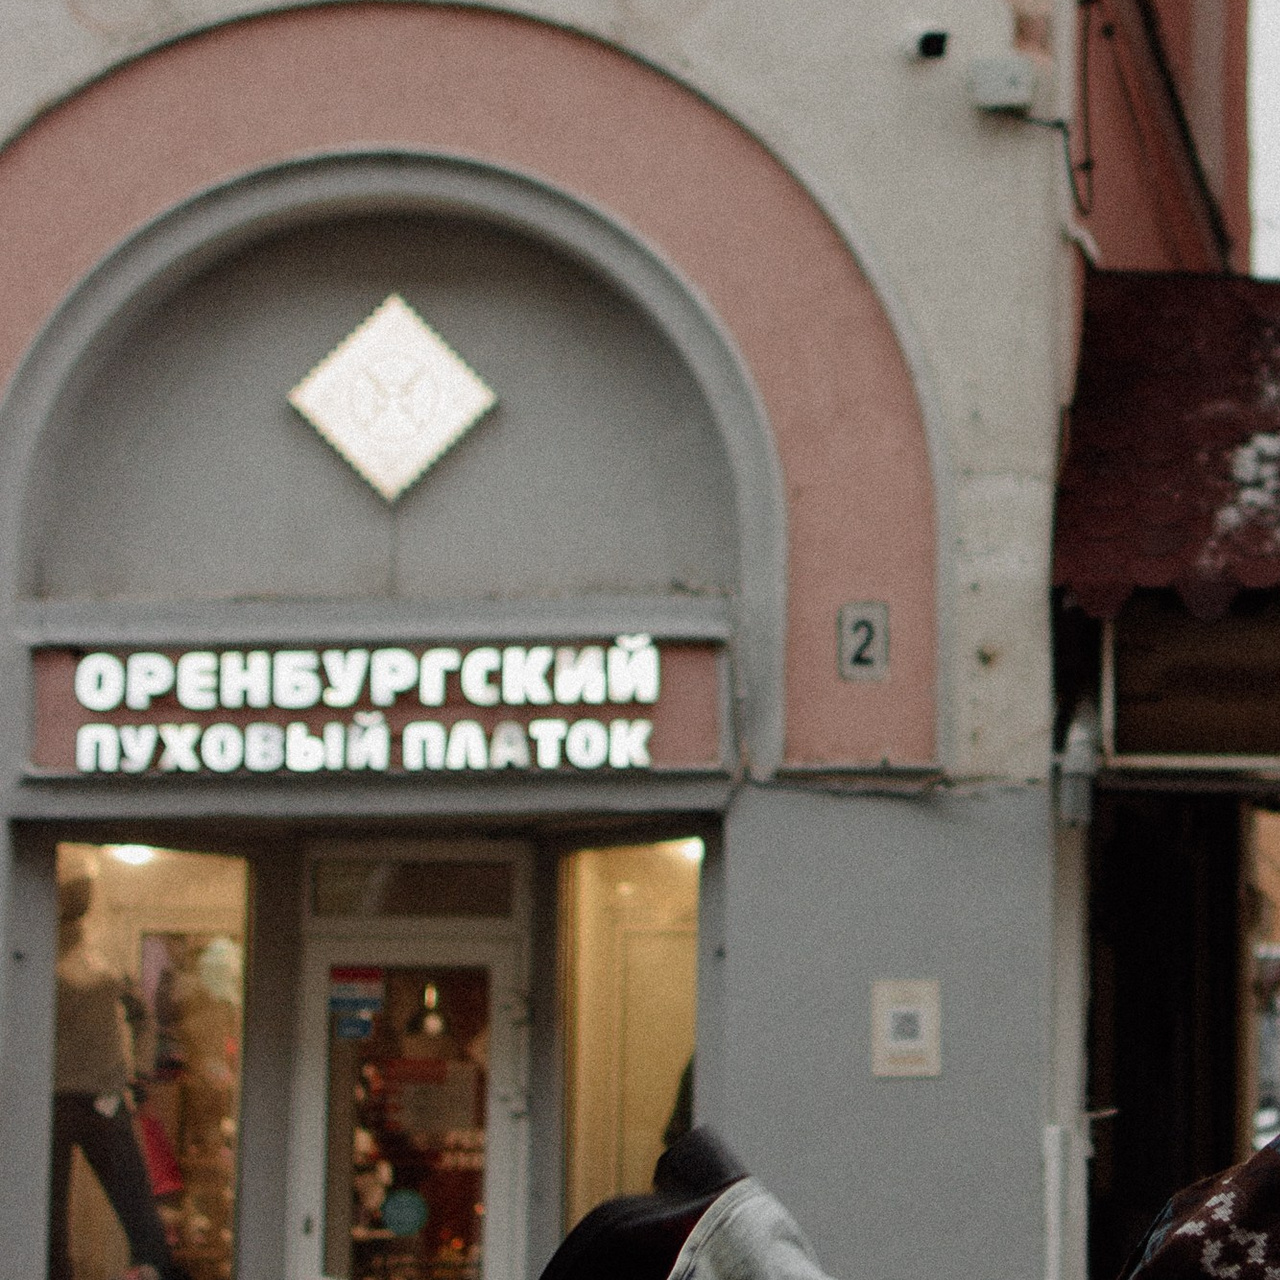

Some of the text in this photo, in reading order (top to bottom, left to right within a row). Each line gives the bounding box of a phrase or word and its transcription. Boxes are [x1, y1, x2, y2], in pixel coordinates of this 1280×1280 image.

[74, 632, 661, 711] ОРЕНБУРГСКИЙ
[851, 619, 875, 666] 2
[75, 710, 653, 773] ПУХОВЫЙ ПЛАТОК
